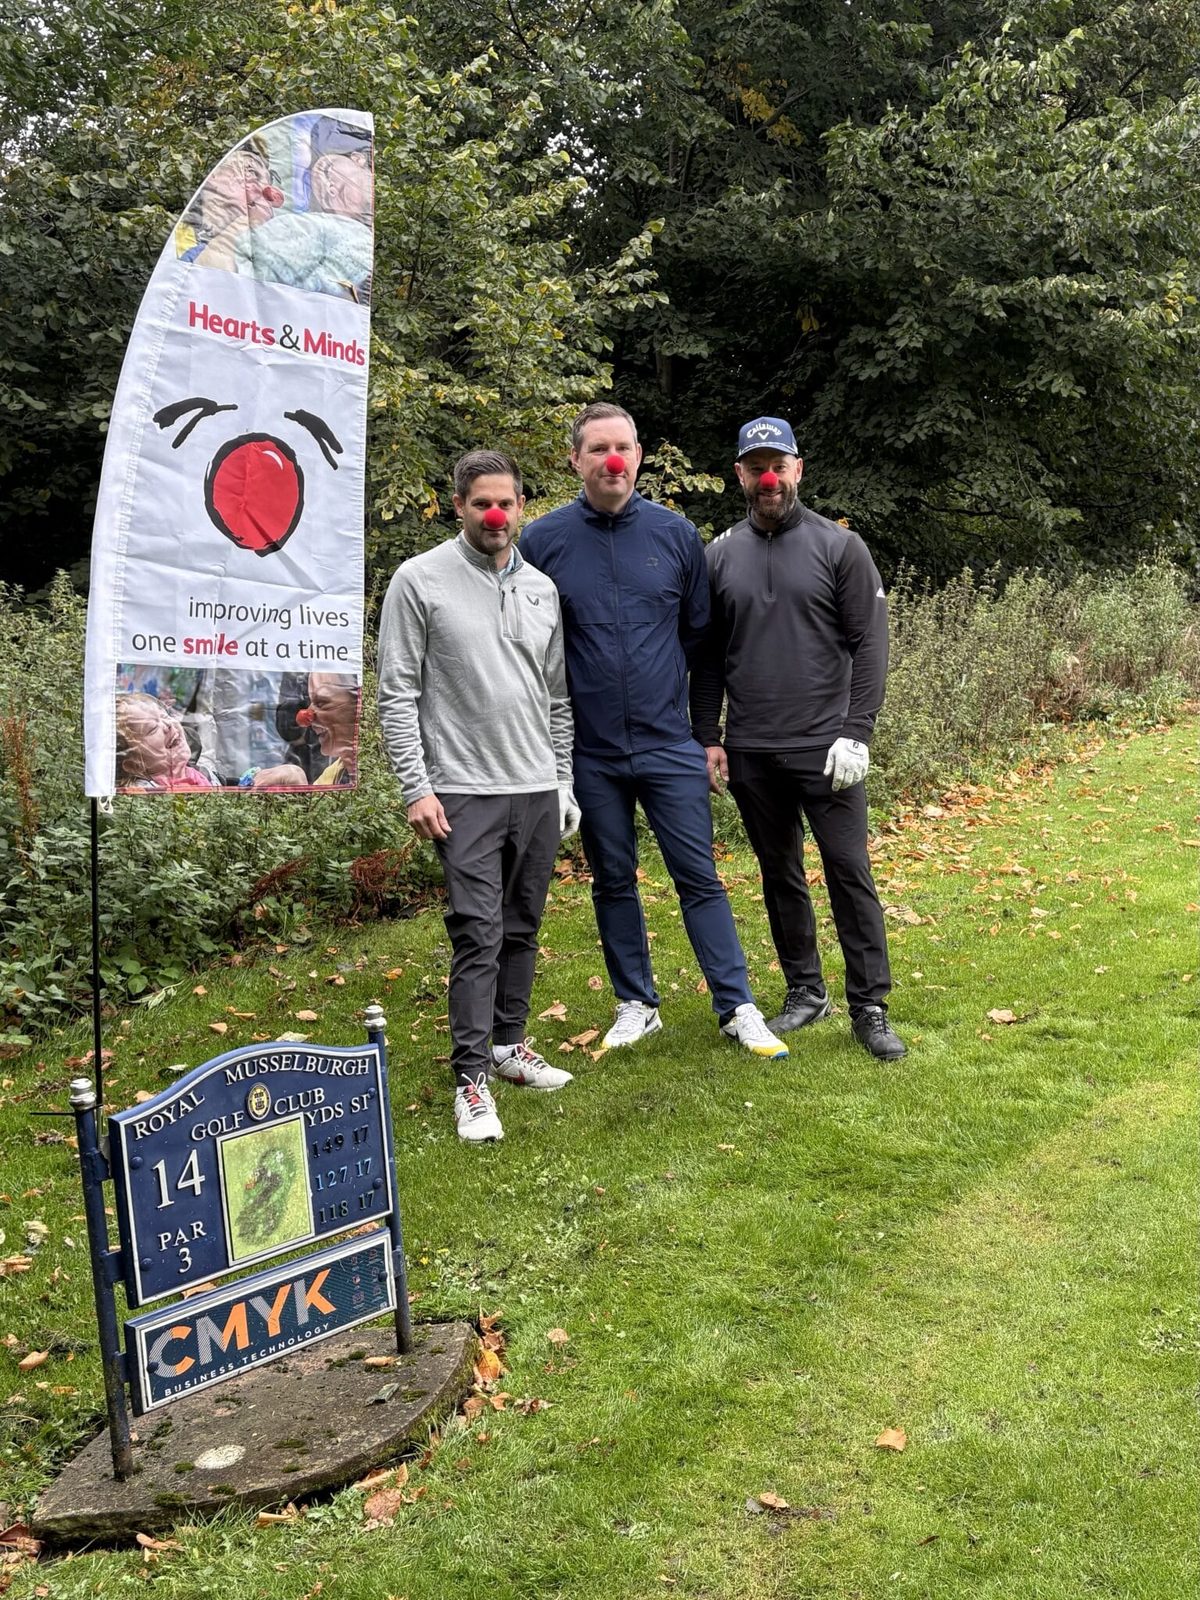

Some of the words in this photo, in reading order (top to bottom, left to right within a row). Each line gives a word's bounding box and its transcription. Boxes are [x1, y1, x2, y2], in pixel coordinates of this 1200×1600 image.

[189, 597, 292, 629] improving
[299, 604, 350, 628] lives
[132, 633, 177, 653] one
[183, 633, 239, 656] smile
[245, 639, 269, 657] at
[276, 643, 290, 658] a
[298, 639, 349, 661] time
[133, 1090, 206, 1141] ROYAL
[224, 1054, 370, 1087] MUSSELBURGH
[190, 1109, 246, 1142] GOLF
[273, 1087, 326, 1116] CLUB
[305, 1101, 345, 1128] YDS
[151, 1148, 206, 1211] 14
[315, 1165, 348, 1191] 127
[355, 1157, 372, 1178] 17
[319, 1200, 349, 1224] 118
[358, 1190, 375, 1210] 17
[158, 1220, 207, 1251] PAR
[178, 1247, 193, 1273] 3
[148, 1268, 337, 1379] CMYK
[164, 1363, 234, 1396] BUSINESS
[241, 1323, 330, 1364] TECHNOLOGY
